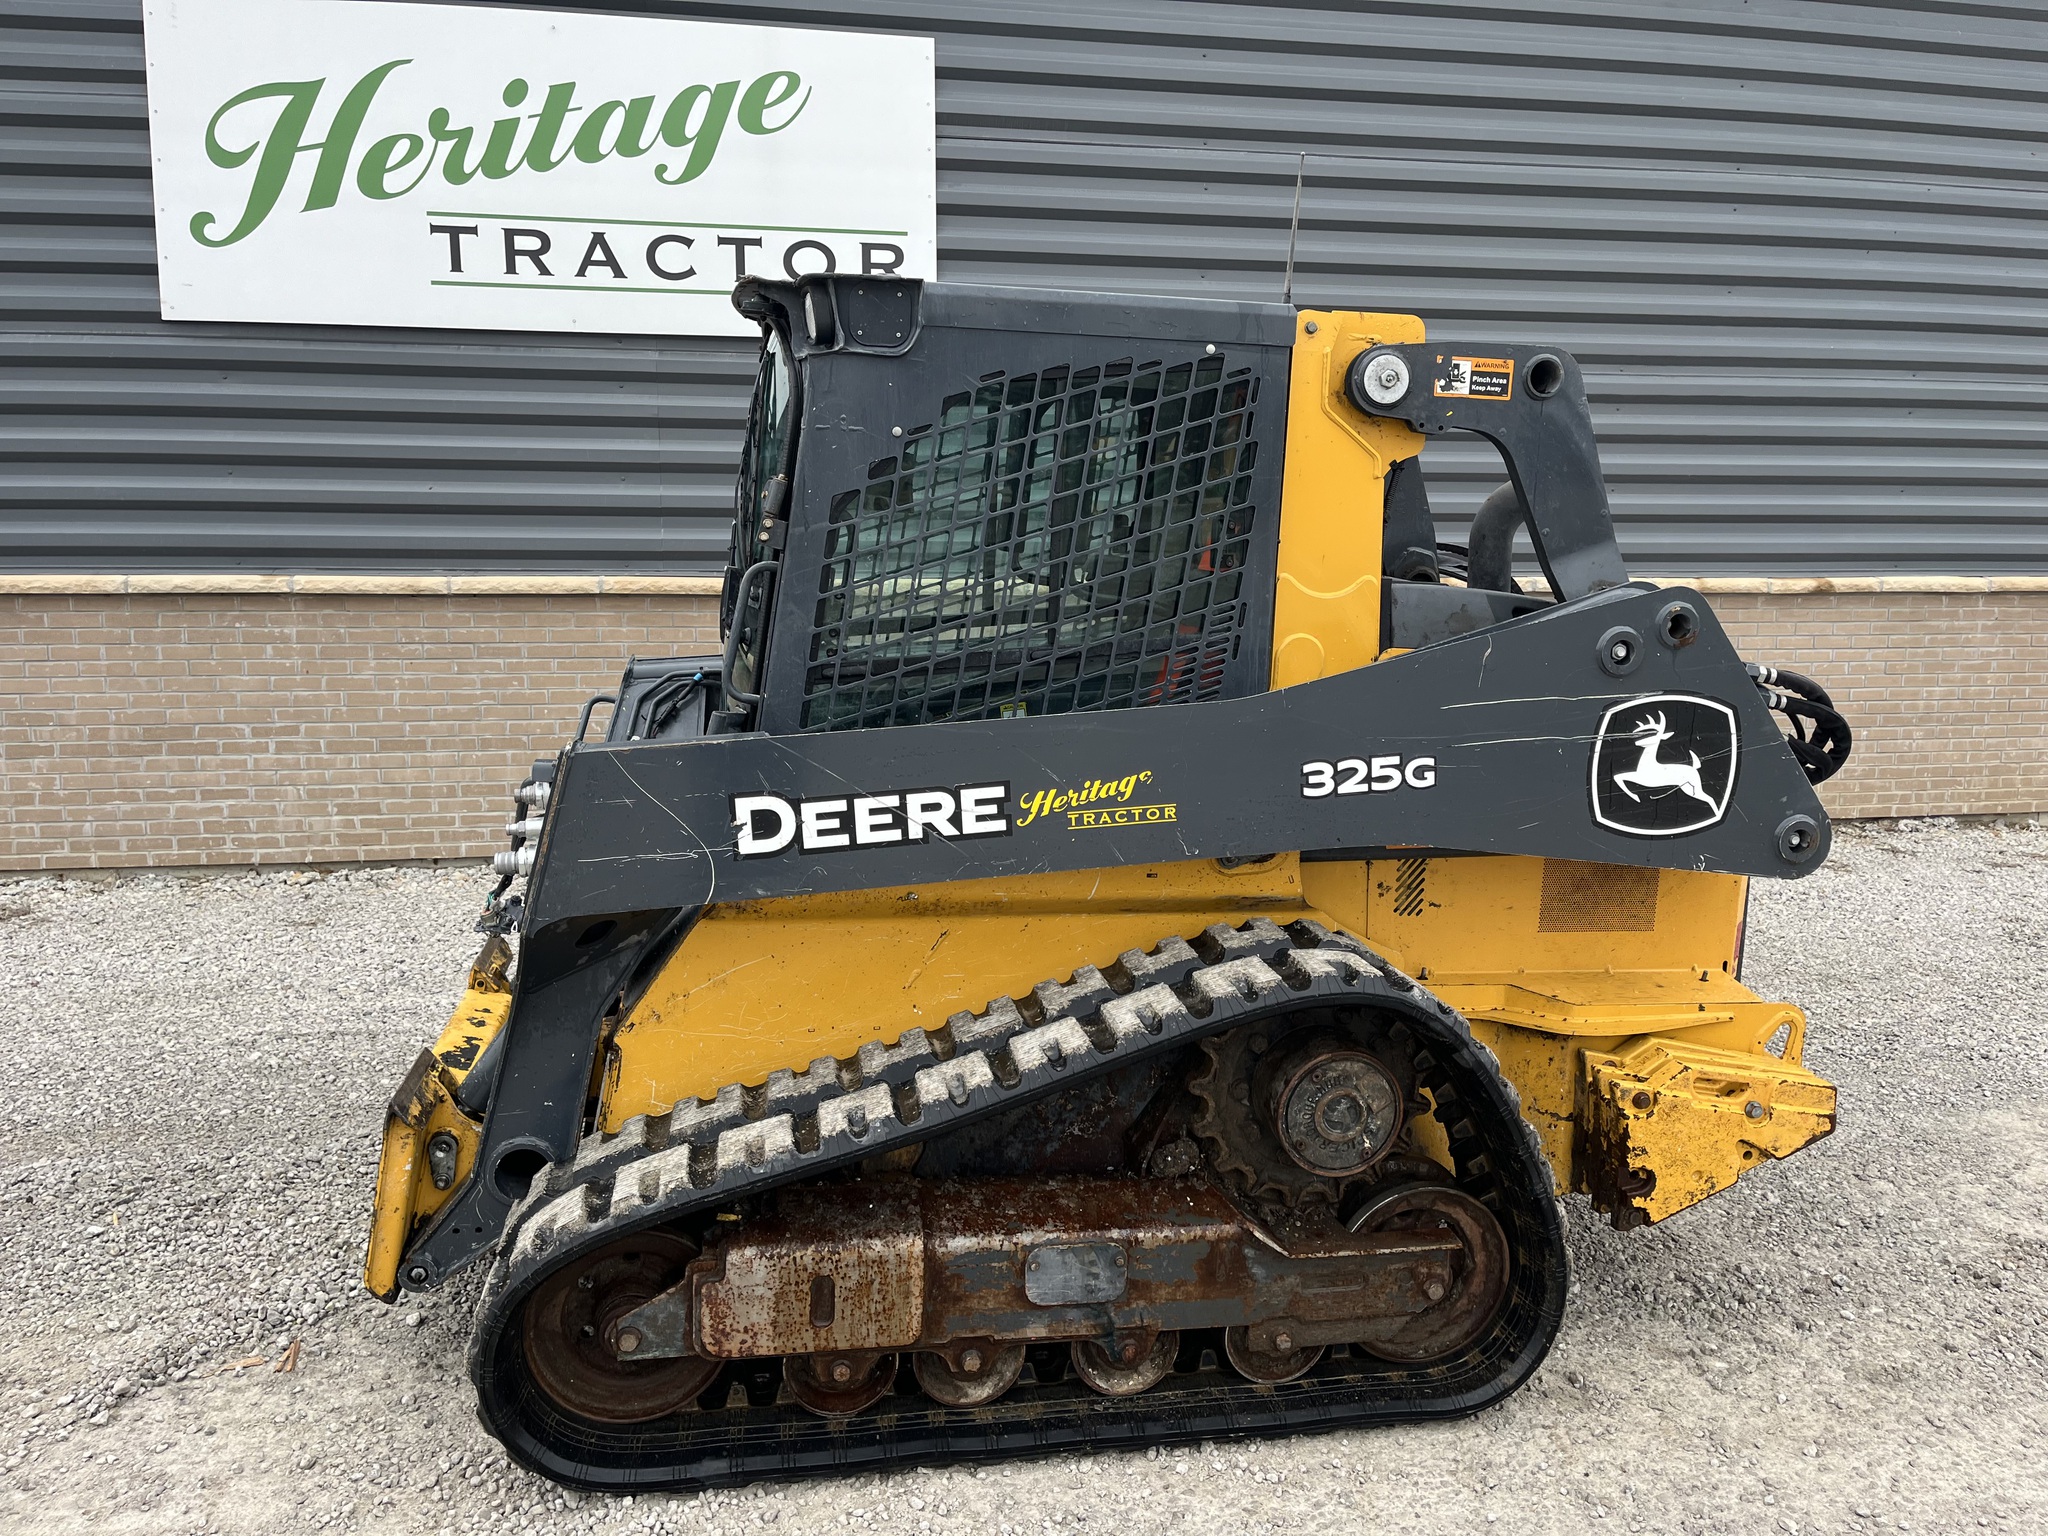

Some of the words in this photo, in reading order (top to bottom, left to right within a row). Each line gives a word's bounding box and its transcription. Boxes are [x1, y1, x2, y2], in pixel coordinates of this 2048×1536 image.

[190, 58, 811, 248] Heritage
[429, 222, 905, 281] TRACTOR
[1471, 384, 1486, 392] Keep
[1486, 385, 1502, 393] Away
[1472, 375, 1491, 383] Pinch
[1016, 770, 1154, 827] Heritage
[1302, 755, 1435, 797] 325G
[733, 785, 1007, 855] DEERE
[1068, 807, 1177, 827] TRACTOR
